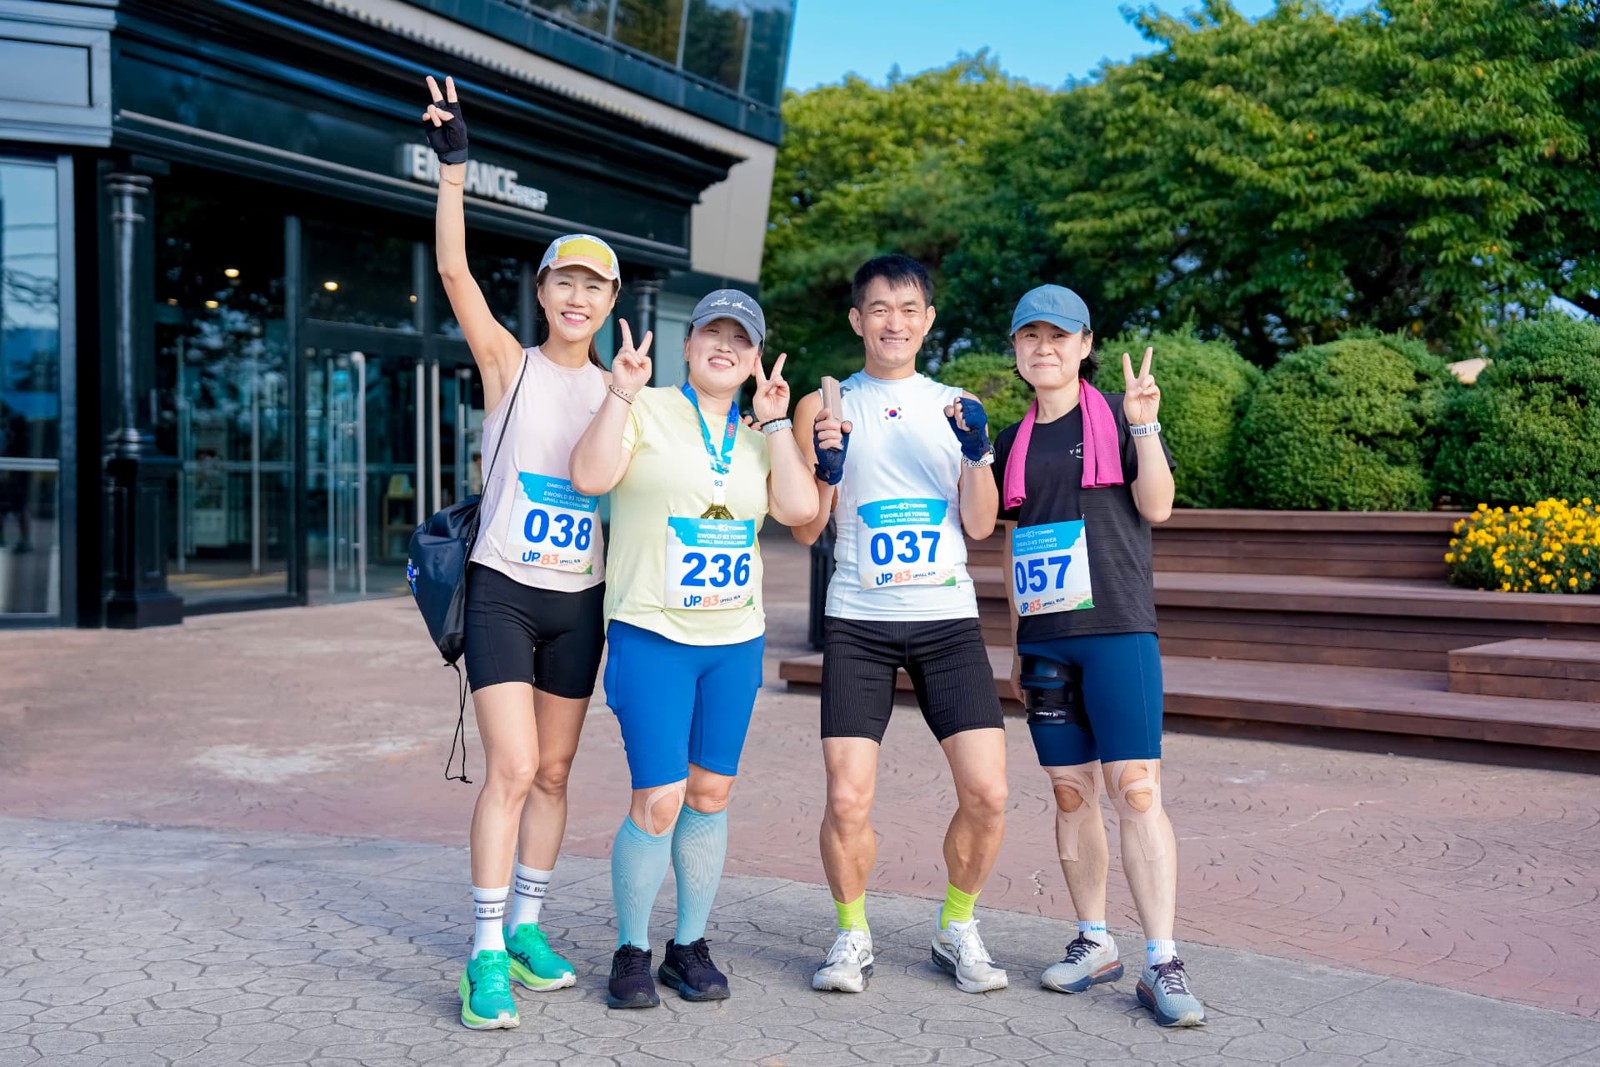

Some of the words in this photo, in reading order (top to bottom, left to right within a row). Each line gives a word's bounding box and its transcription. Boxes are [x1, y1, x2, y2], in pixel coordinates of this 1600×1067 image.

[524, 509, 592, 551] 038
[522, 550, 541, 562] UP
[541, 554, 559, 565] 83
[870, 530, 940, 566] 037
[680, 552, 751, 588] 236
[876, 573, 893, 586] UP
[894, 570, 912, 584] 83
[1015, 555, 1072, 594] 057
[684, 594, 702, 607] UP
[702, 594, 720, 607] 83
[1021, 601, 1029, 614] UP
[1030, 599, 1041, 613] 83
